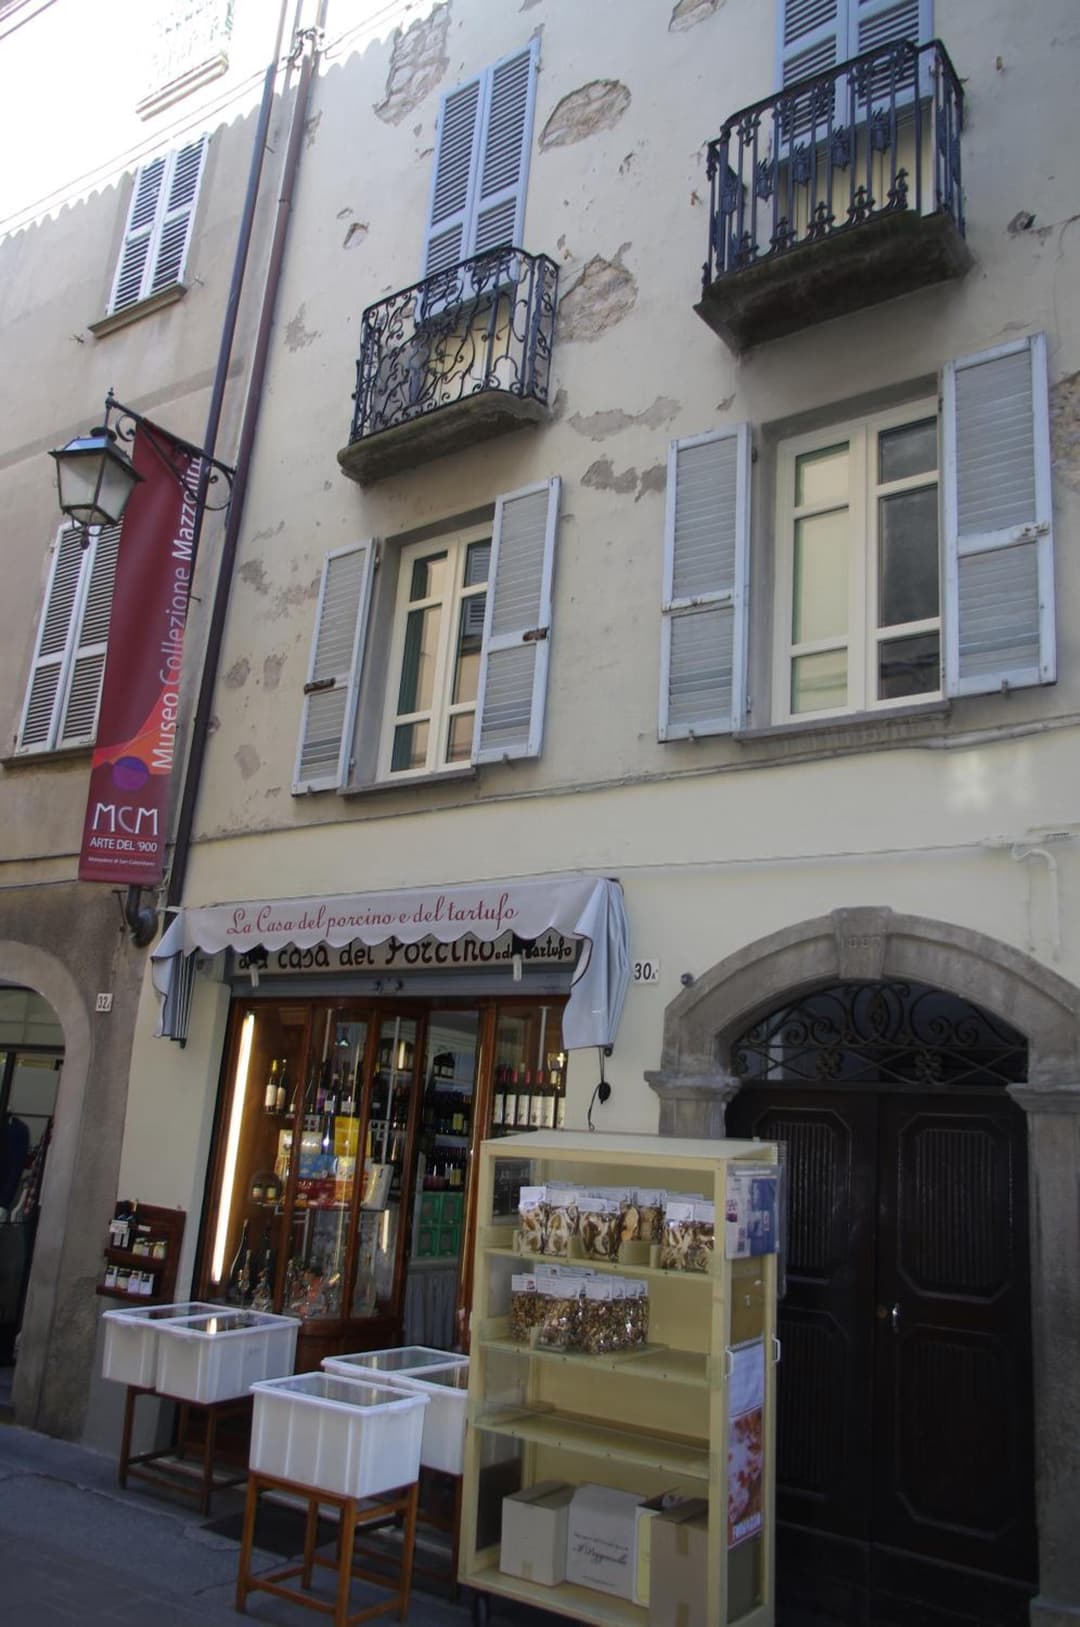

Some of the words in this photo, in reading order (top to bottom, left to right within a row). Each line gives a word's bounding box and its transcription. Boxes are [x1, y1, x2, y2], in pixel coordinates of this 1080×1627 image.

[159, 567, 191, 686] Collezione
[152, 692, 179, 769] Museo
[92, 802, 158, 836] MCM
[89, 837, 115, 849] ARTE
[116, 839, 136, 851] DEL
[227, 907, 251, 935] La
[256, 904, 295, 934] Casa
[298, 904, 327, 929] del
[325, 907, 395, 938] porcino
[399, 911, 410, 924] e
[413, 895, 446, 924] del
[447, 892, 520, 931] tartufo
[277, 945, 330, 969] casa
[339, 943, 375, 966] del
